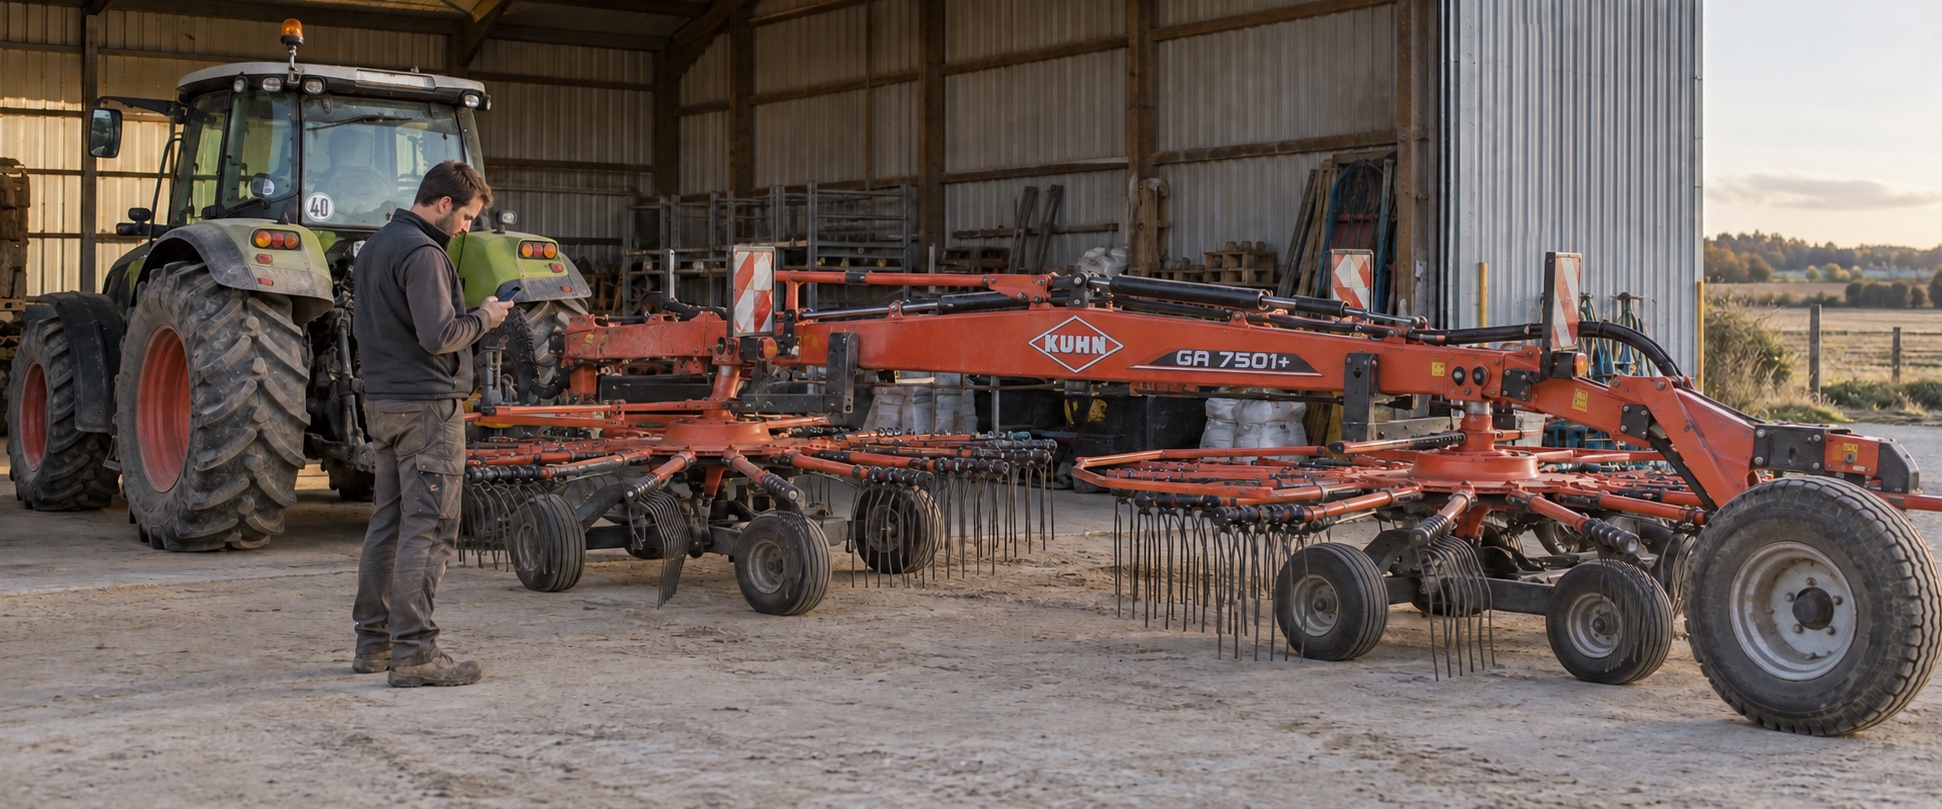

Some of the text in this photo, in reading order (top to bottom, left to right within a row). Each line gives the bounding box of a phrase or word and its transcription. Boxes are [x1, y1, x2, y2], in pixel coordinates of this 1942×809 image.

[310, 197, 329, 217] 40
[1044, 334, 1106, 355] KUHN
[1176, 349, 1290, 369] GA 7501+
